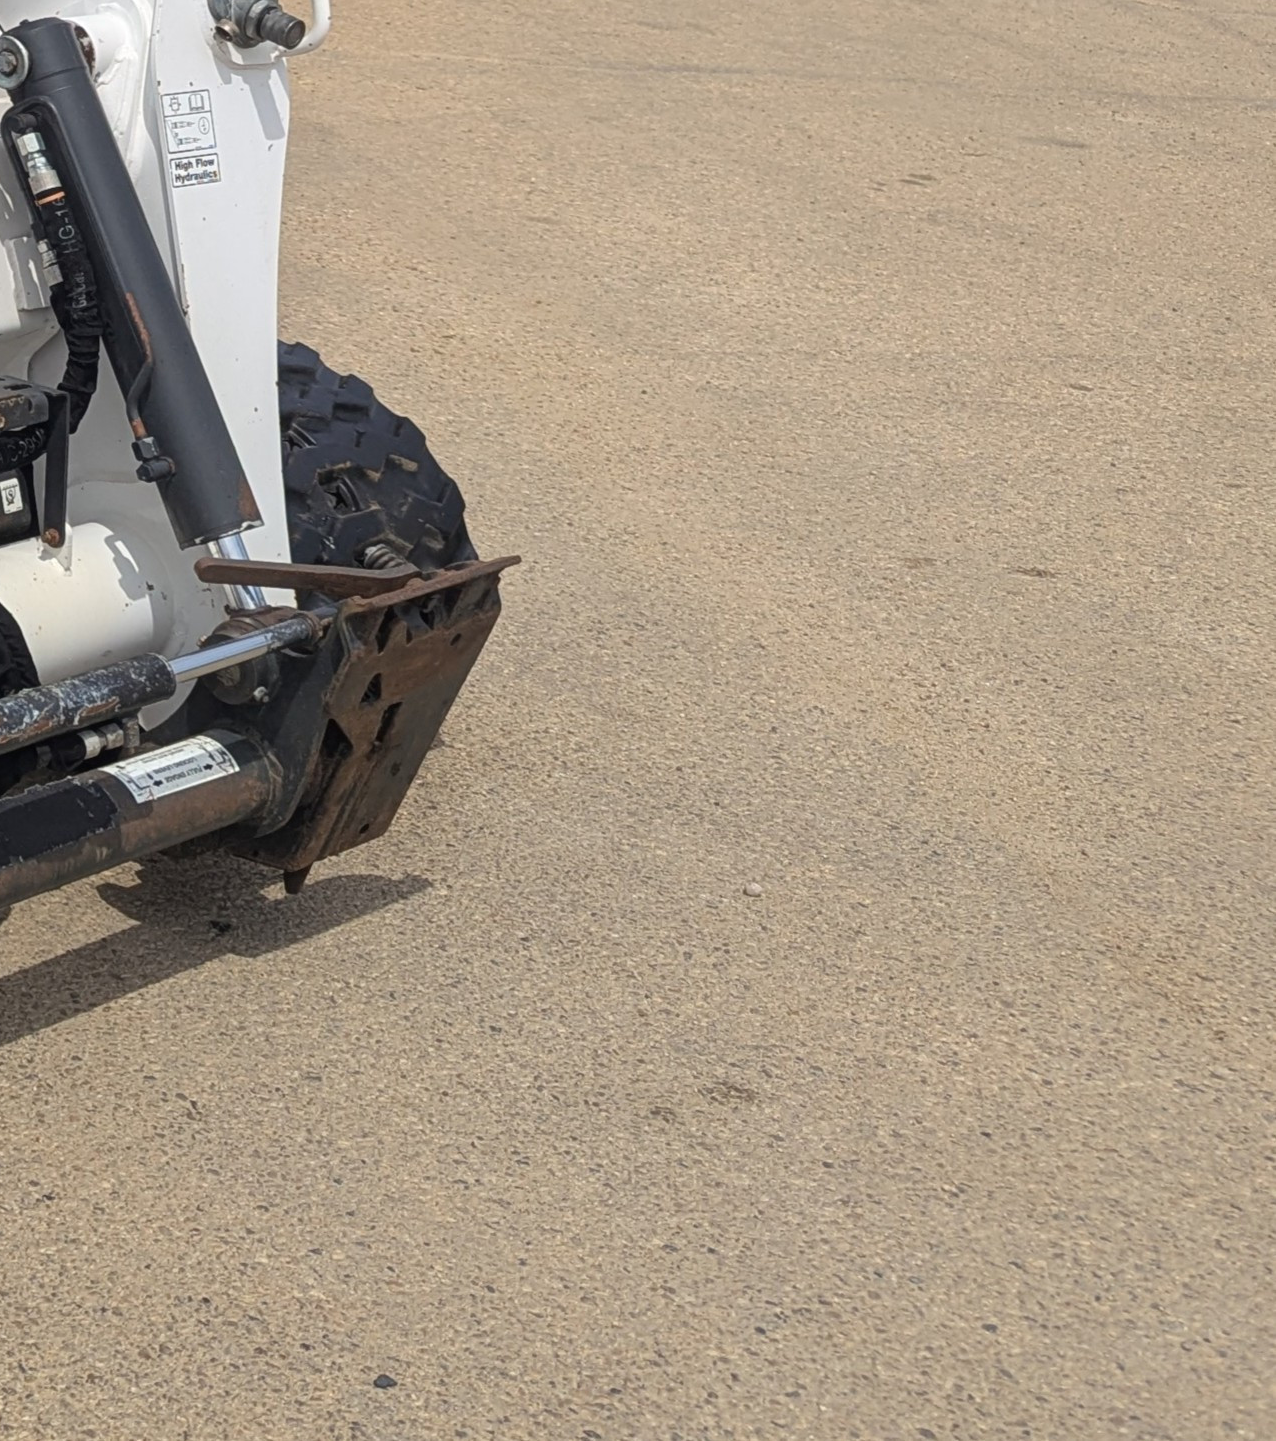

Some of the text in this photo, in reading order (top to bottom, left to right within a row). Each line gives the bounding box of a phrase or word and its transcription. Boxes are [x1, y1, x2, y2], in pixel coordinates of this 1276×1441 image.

[174, 158, 215, 172] High Flow
[174, 170, 218, 185] Hydraulics
